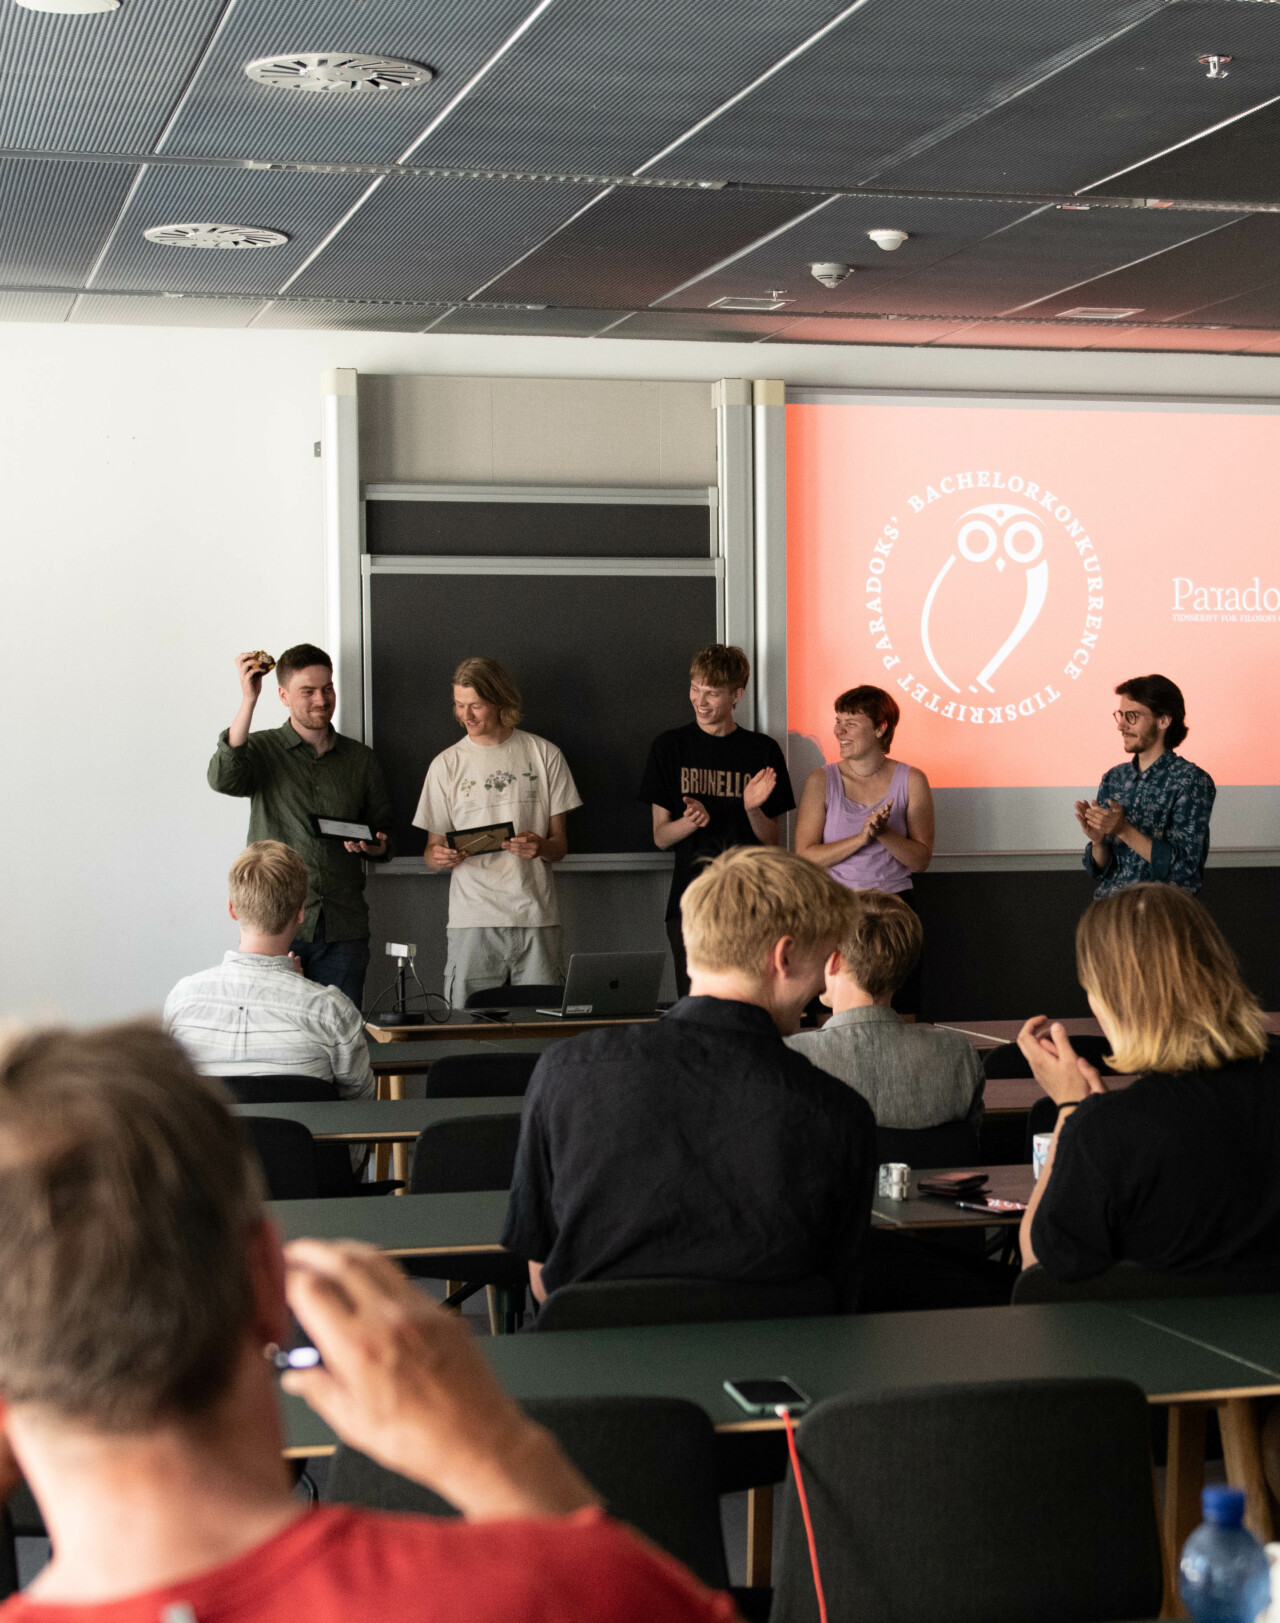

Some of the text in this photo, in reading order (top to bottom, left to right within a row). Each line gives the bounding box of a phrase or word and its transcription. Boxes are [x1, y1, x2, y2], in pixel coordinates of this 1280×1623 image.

[907, 471, 1104, 680] BACHELORKONKURRENCE
[1221, 614, 1238, 622] FOR
[1240, 614, 1276, 622] FILOSOFI
[897, 673, 1061, 724] TIDSKRIFTET
